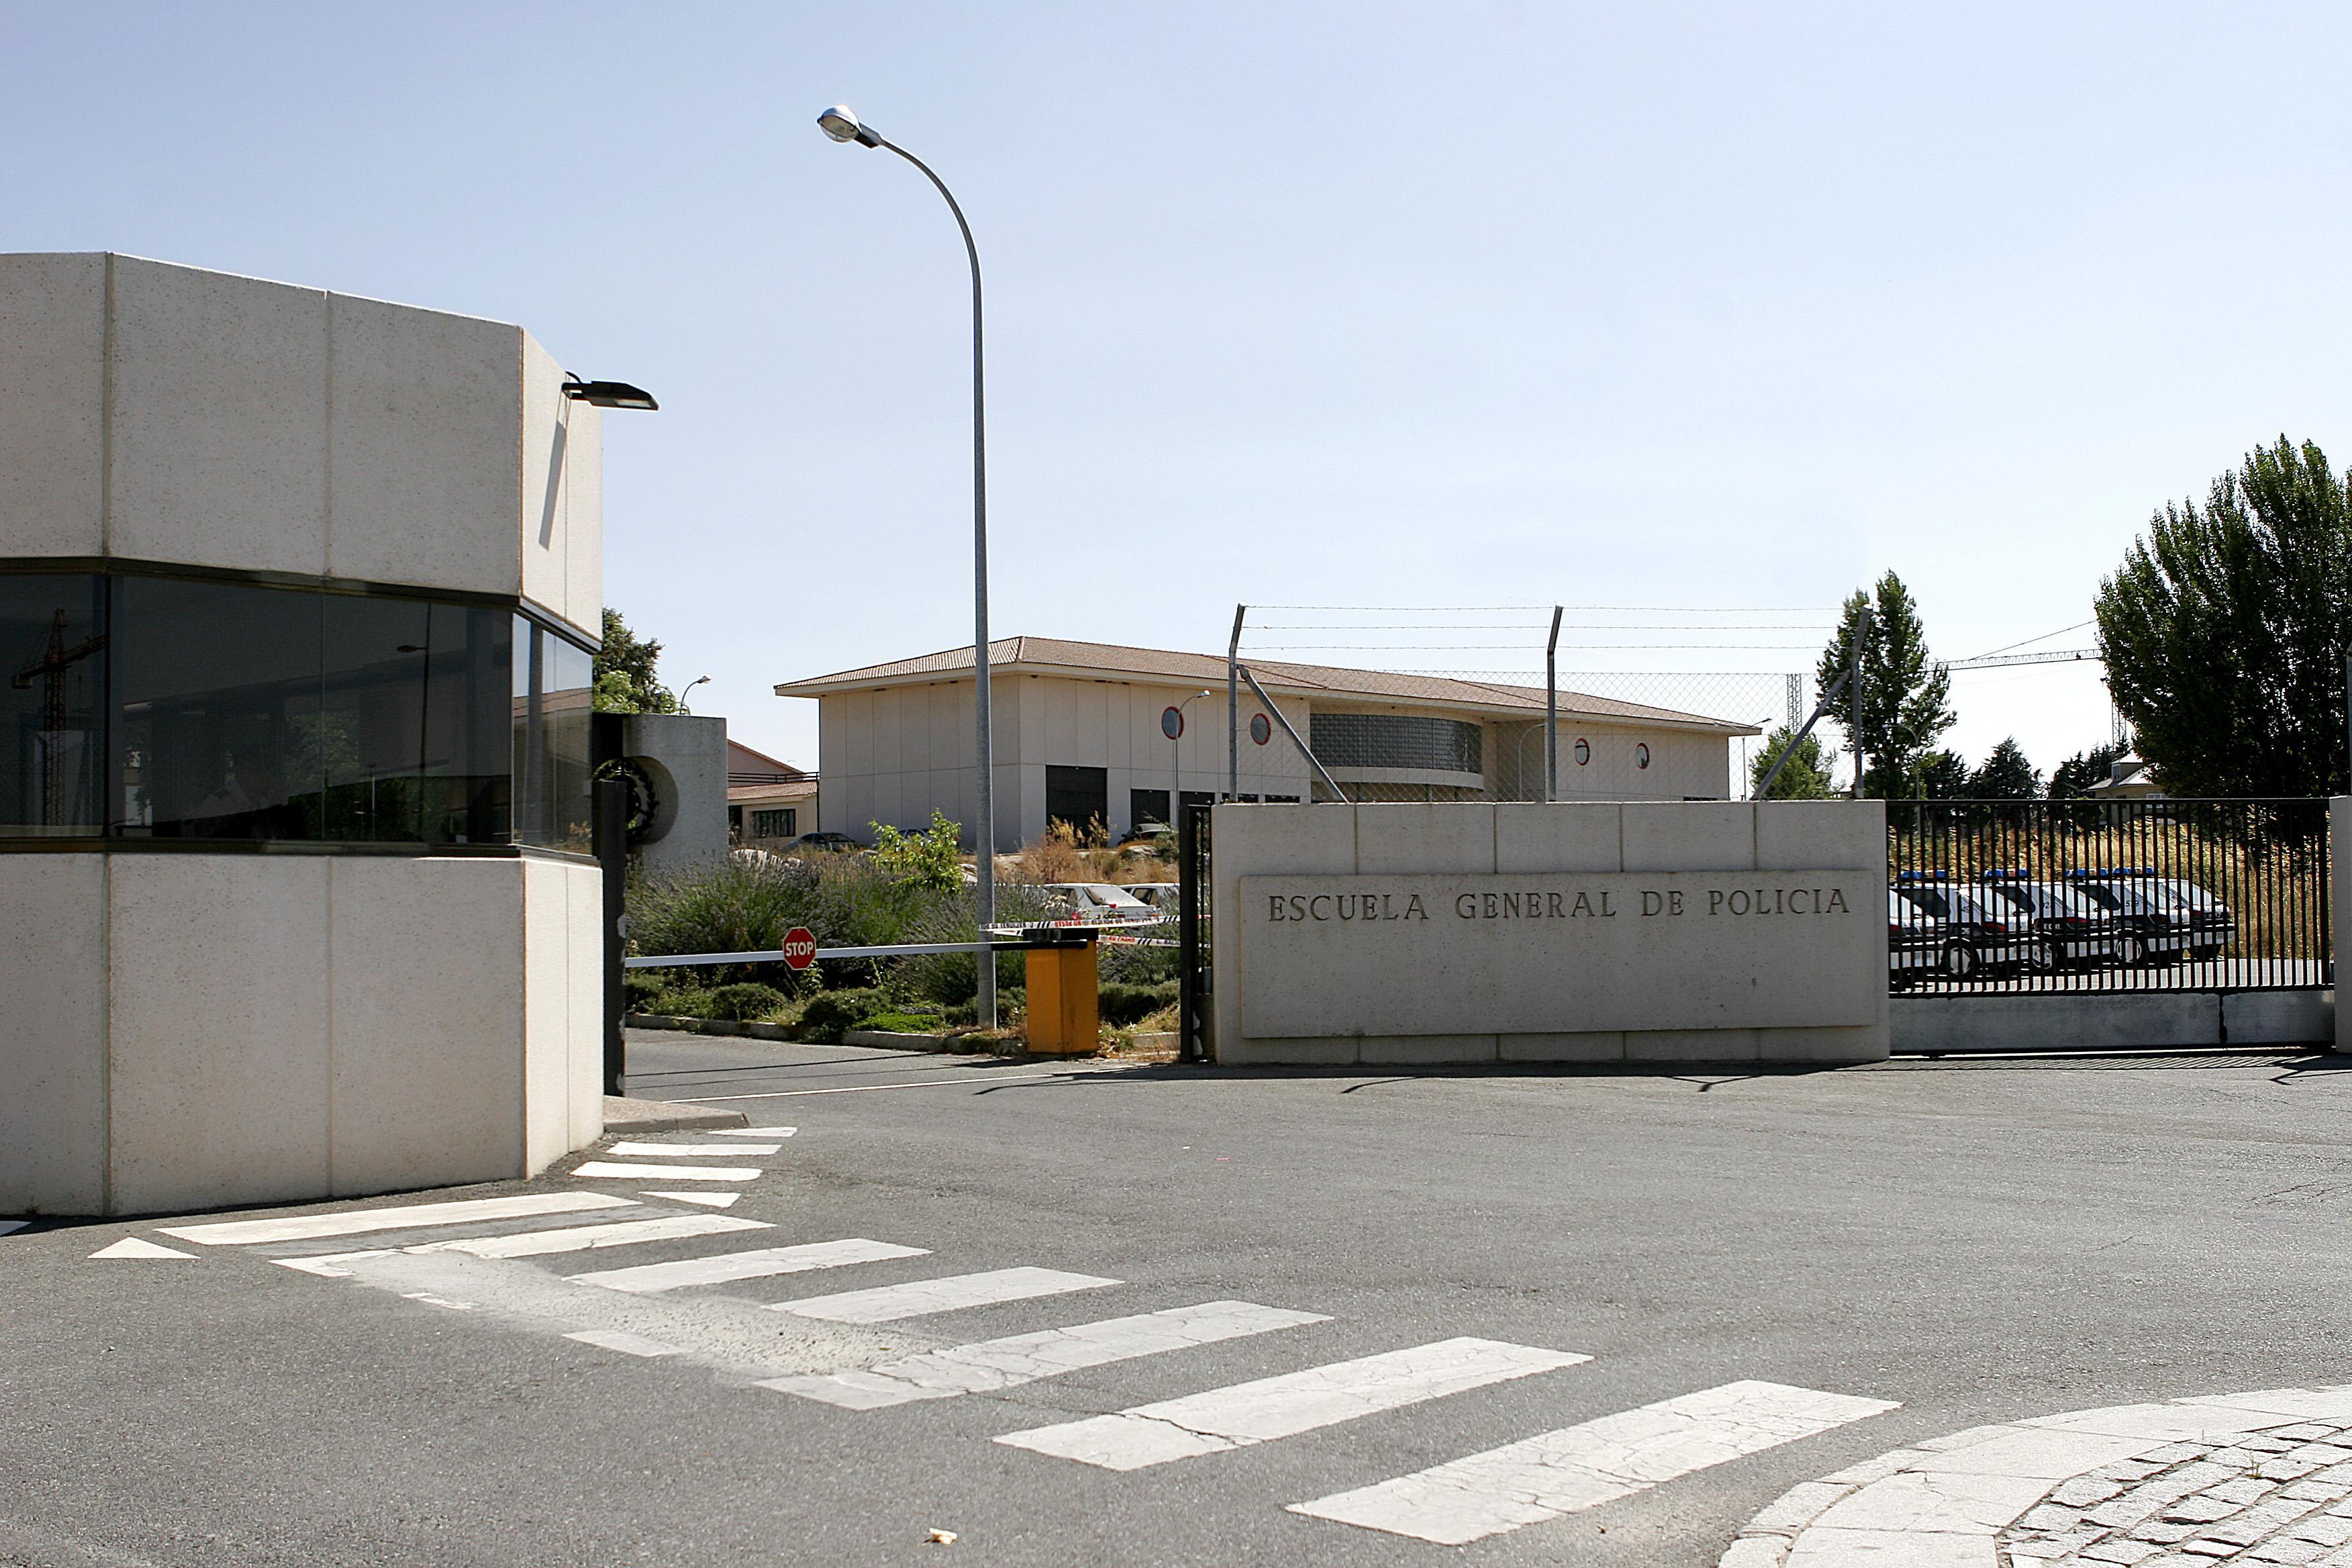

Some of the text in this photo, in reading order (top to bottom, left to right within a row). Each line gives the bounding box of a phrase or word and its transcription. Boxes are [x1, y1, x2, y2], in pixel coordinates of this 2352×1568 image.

[1268, 889, 1850, 922] ESCUELA GENERAL DE POLICIA
[785, 941, 814, 957] STOP
